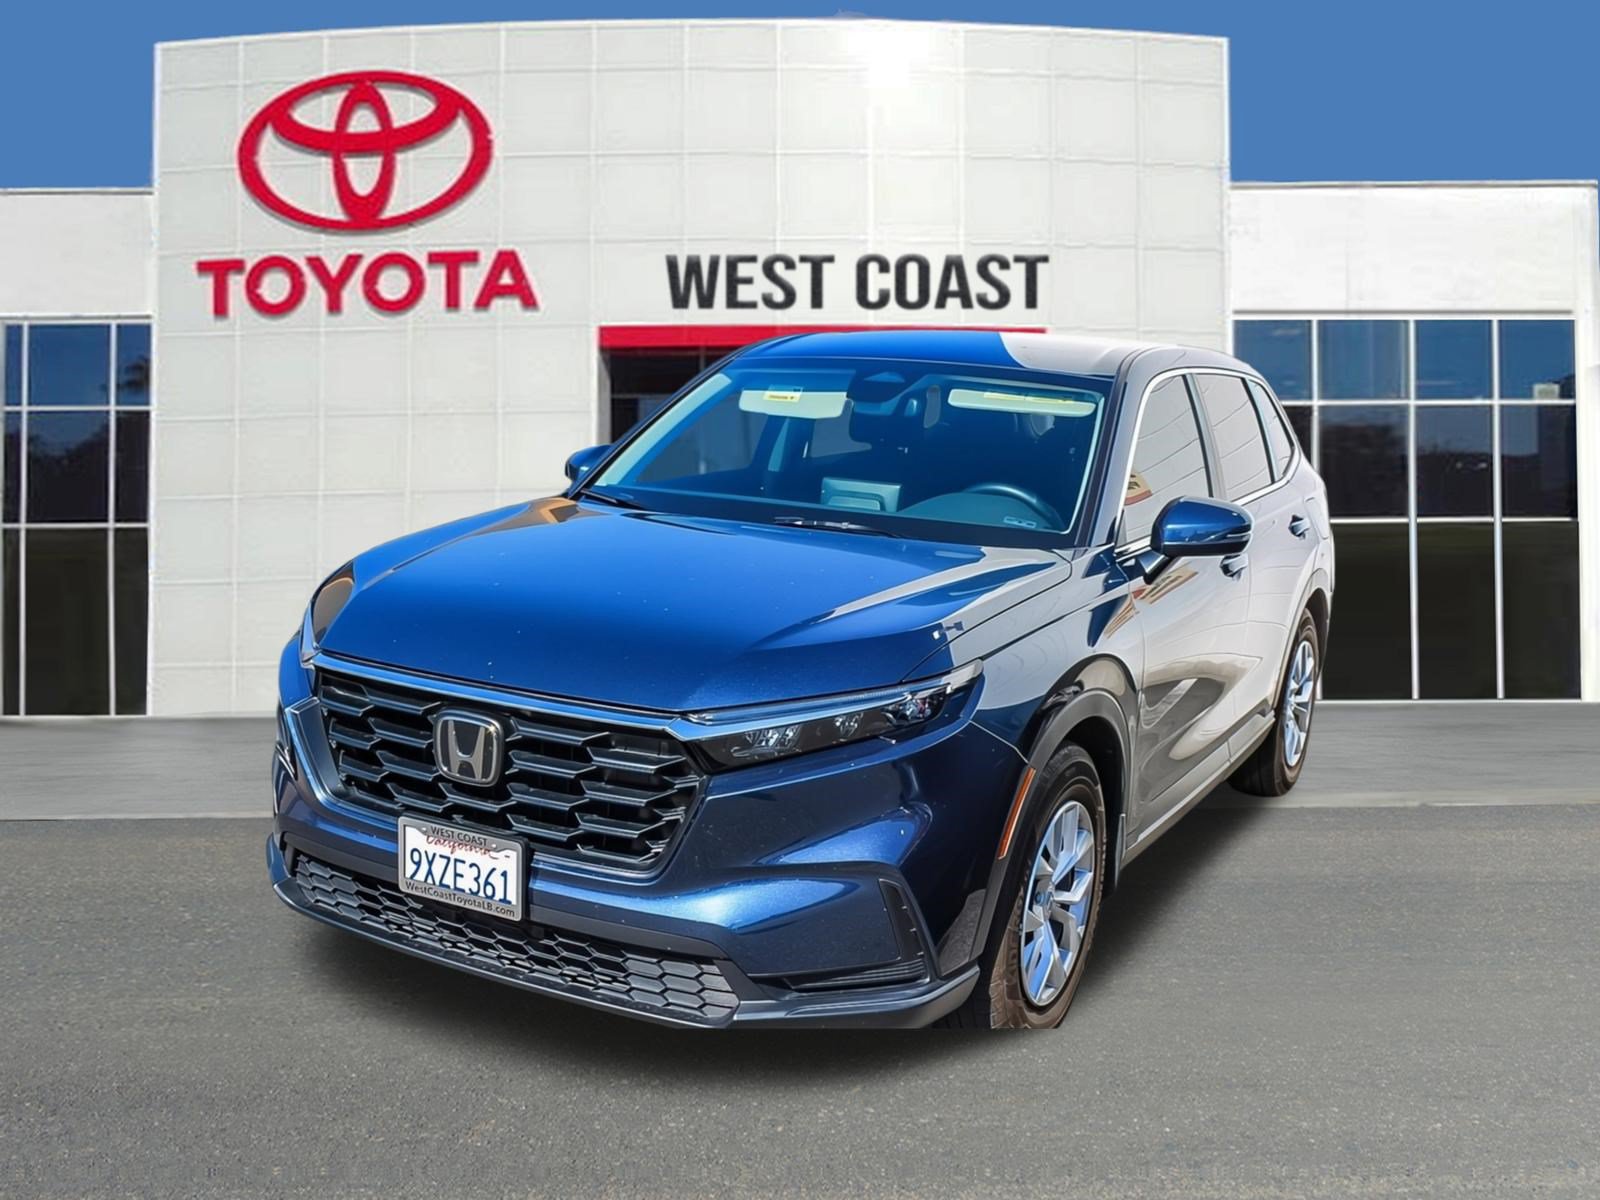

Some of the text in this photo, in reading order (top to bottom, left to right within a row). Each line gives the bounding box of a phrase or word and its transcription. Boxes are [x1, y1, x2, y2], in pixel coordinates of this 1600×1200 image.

[197, 249, 539, 317] TOYOTA
[666, 254, 1049, 310] WEST COAST
[430, 826, 488, 847] WEST COAST
[405, 881, 515, 917] WestCoastToyotaLB.com
[410, 848, 512, 905] 9XZE361
